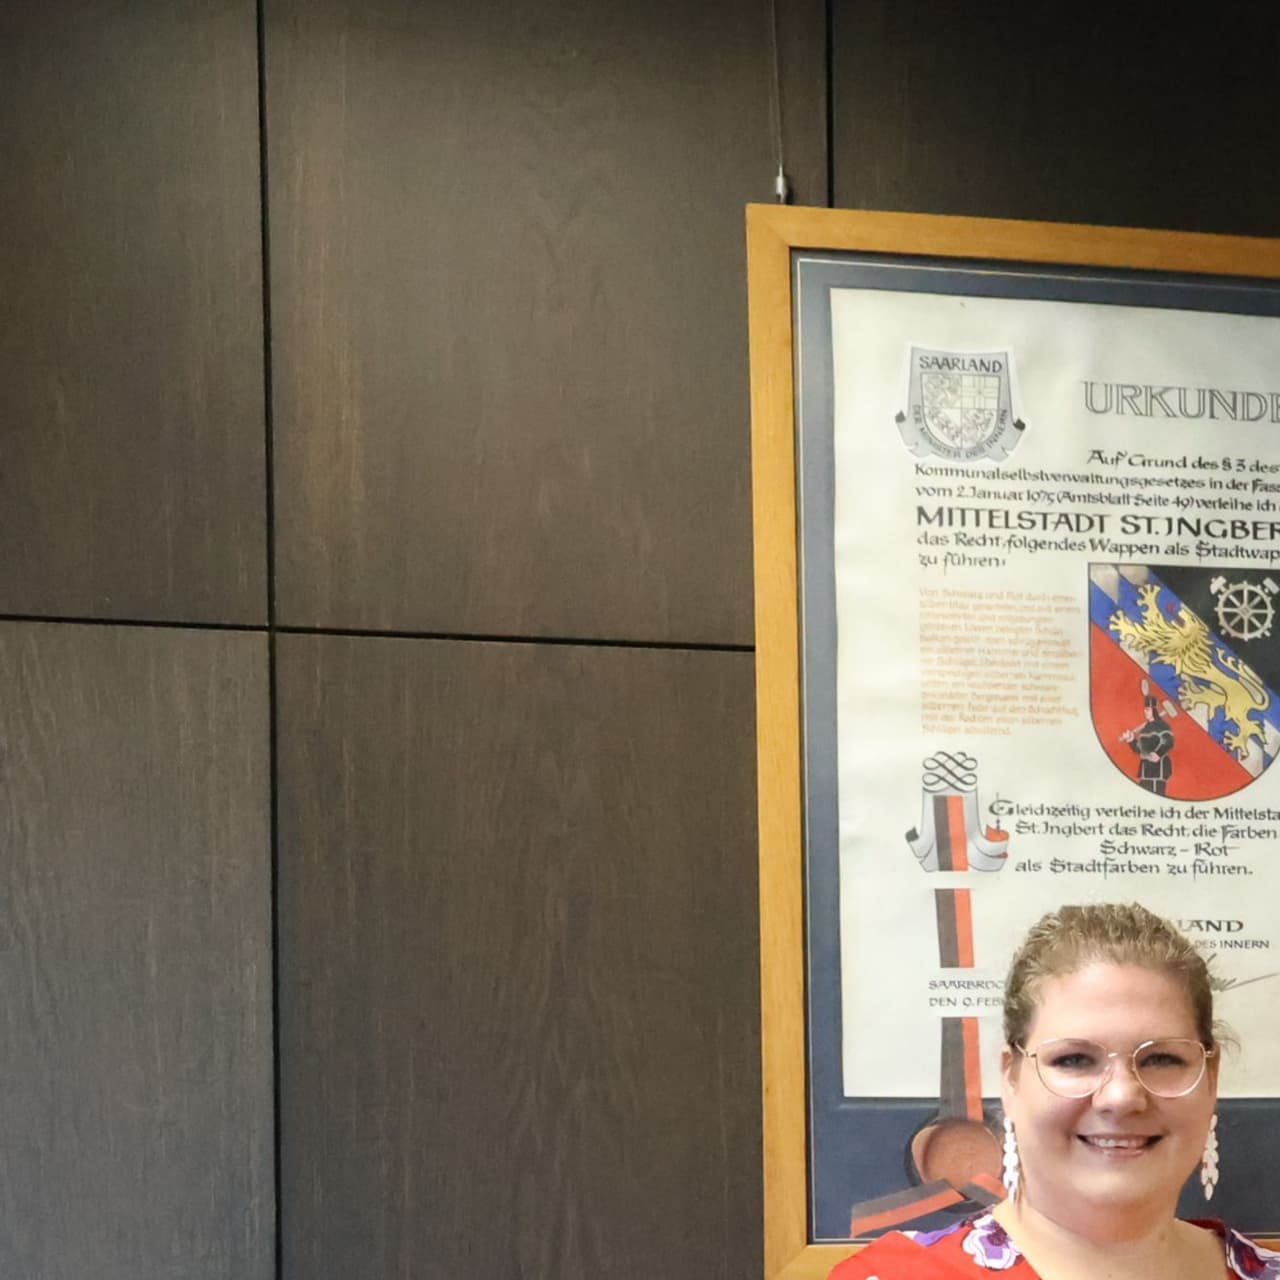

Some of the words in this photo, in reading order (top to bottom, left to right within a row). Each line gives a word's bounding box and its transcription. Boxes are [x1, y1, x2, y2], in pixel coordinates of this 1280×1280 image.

[919, 355, 1003, 373] SAARLAND
[1087, 449, 1127, 466] Auf
[1128, 453, 1187, 469] Grund
[1191, 457, 1219, 470] des
[1249, 460, 1280, 474] des
[1209, 477, 1223, 489] in
[1226, 478, 1248, 491] der
[915, 486, 953, 498] vom
[1133, 494, 1169, 507] Seite
[1196, 497, 1253, 512] verleihe
[1256, 498, 1276, 512] ich
[916, 505, 1112, 534] MITTELSTADT
[917, 531, 949, 547] das
[1005, 534, 1087, 554] folgendes
[1088, 537, 1160, 559] Wappen
[1164, 542, 1190, 556] als
[919, 554, 937, 568] zu
[989, 798, 1091, 820] Gleichzeitig
[1095, 806, 1156, 820] verleihe
[1160, 805, 1181, 819] ich
[1185, 806, 1210, 820] der
[1108, 822, 1137, 836] das
[1192, 823, 1217, 838] die
[1221, 824, 1278, 844] Farben
[1100, 840, 1178, 857] Schwarz
[1194, 843, 1241, 857] Rot
[1015, 859, 1043, 873] als
[1049, 856, 1160, 880] Stadtfarben
[1166, 862, 1188, 875] zu
[1191, 859, 1253, 881] führen.
[1176, 919, 1245, 933] LAND
[1219, 939, 1270, 949] INNERN
[928, 997, 957, 1007] DEN
